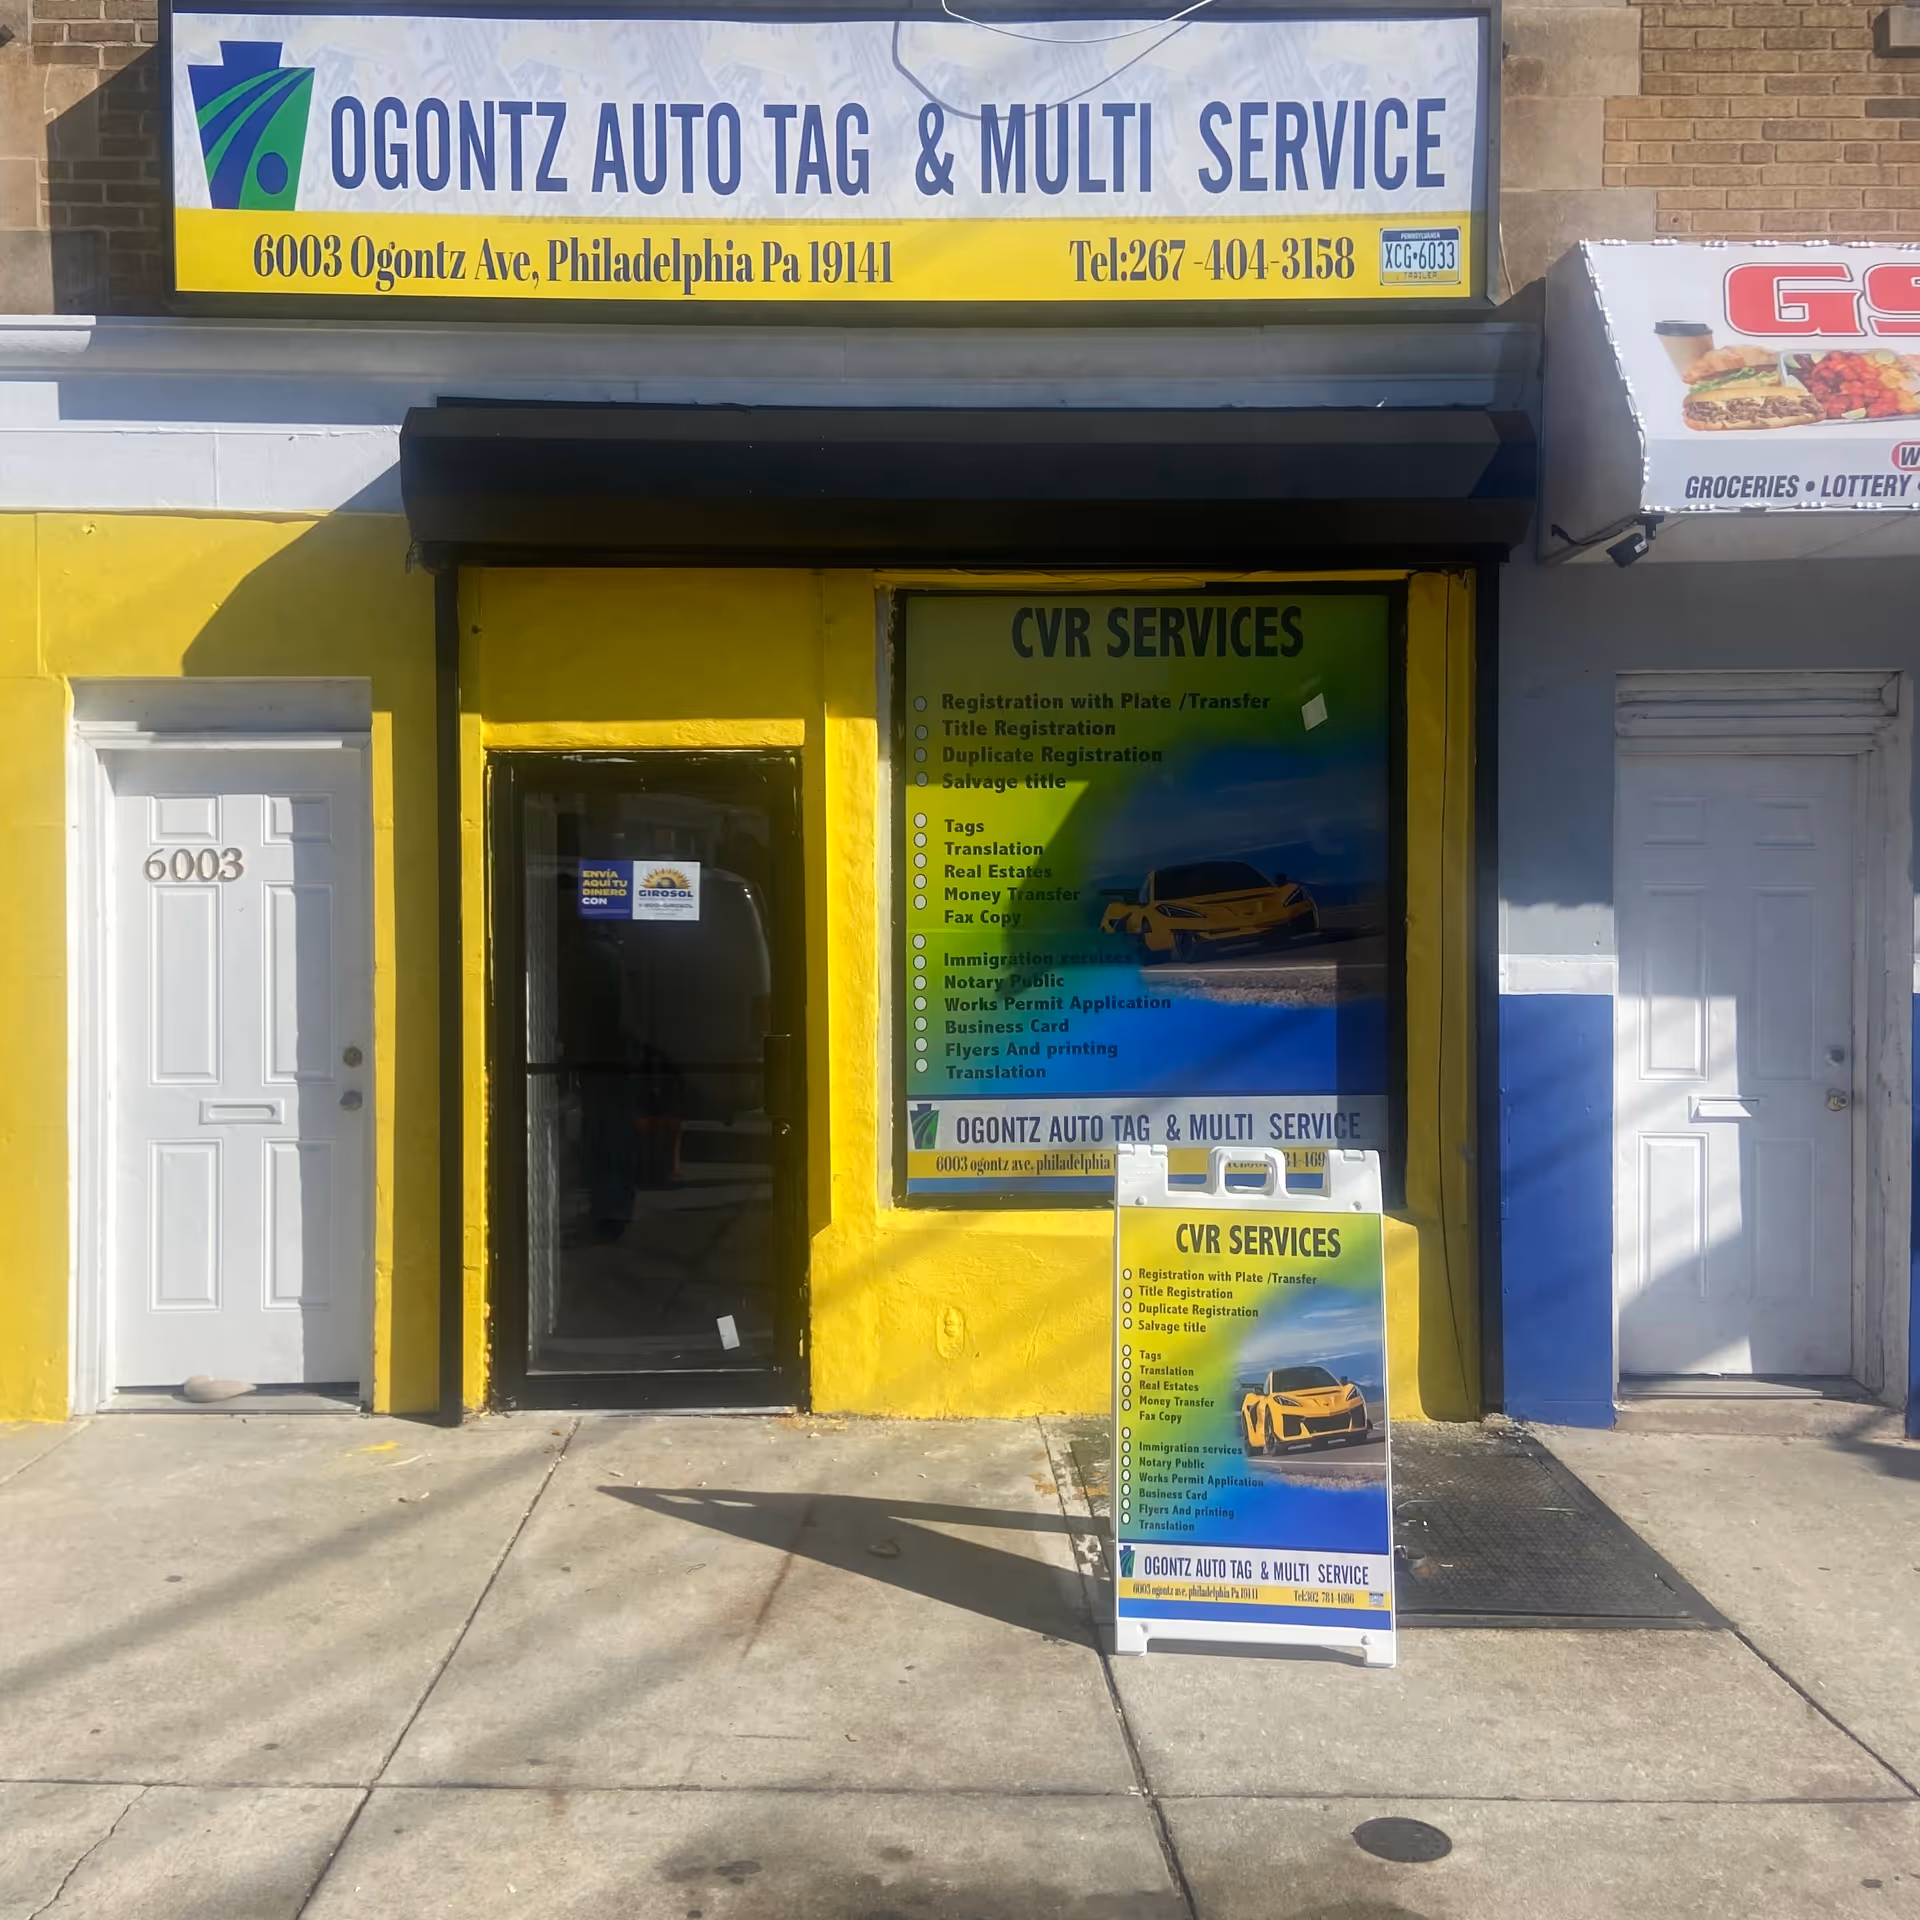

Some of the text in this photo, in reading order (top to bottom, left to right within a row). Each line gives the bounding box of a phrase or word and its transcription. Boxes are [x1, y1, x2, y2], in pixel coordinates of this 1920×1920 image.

[330, 96, 1447, 196] OGONTZ AUTO TAG & MULTI SERVICE
[253, 233, 893, 295] 6003 Ogontz Ave, Philadelphia Pa 19141
[1685, 474, 1912, 499] GROCERIES LOTTERY
[1012, 605, 1303, 658] CVR SERVICES
[942, 693, 1065, 714] Registration
[1071, 693, 1114, 710] with
[1120, 693, 1171, 710] Plate
[942, 720, 1116, 741] Title Registration
[942, 746, 1162, 767] Duplicate Registration
[942, 773, 1066, 793] Salvage title
[944, 819, 984, 837] Tags
[944, 841, 1043, 856] Translation
[143, 847, 244, 882] 6003
[944, 864, 1052, 879] Real Estates
[582, 888, 627, 896] DINERO
[612, 880, 628, 888] TU
[582, 897, 608, 905] CON
[638, 889, 694, 898] GIROSOL
[944, 886, 1080, 904] Money Transfer
[944, 909, 1021, 928] Fax Copy
[944, 951, 1054, 970] Immigration
[944, 973, 1065, 991] Notary Public
[944, 996, 1171, 1014] Works Permit Application
[945, 1019, 1069, 1034] Business Card
[945, 1041, 1118, 1061] Flyers And printing
[946, 1064, 1046, 1080] Translation
[956, 1113, 1361, 1144] OGONTZ AUTO TAG & MULTI SERVICE
[936, 1156, 968, 1172] 6003
[970, 1157, 1009, 1176] ogontz
[1036, 1154, 1111, 1175] philadelphia
[1176, 1223, 1341, 1258] CVR SERVICES
[1139, 1268, 1204, 1282] Registration
[1208, 1271, 1232, 1282] with
[1235, 1272, 1263, 1283] Plate
[1139, 1286, 1233, 1300] Title Registration
[1139, 1303, 1259, 1318] Duplicate Registration
[1138, 1320, 1206, 1334] Salvage title
[1140, 1350, 1161, 1362] Tags
[1140, 1365, 1194, 1376] Translation
[1139, 1380, 1199, 1392] Real Estates
[1139, 1395, 1215, 1408] Money Transfer
[1139, 1411, 1182, 1424] Fax Copy
[1139, 1442, 1243, 1455] Immigration services
[1139, 1457, 1205, 1470] Notary Public
[1139, 1472, 1264, 1488] Works Permit Application
[1139, 1488, 1208, 1500] Business Card
[1139, 1504, 1234, 1519] Flyers And printing
[1139, 1519, 1195, 1531] Translation
[1144, 1556, 1369, 1585] OGONTZ AUTO TAG & MULTI SERVICE
